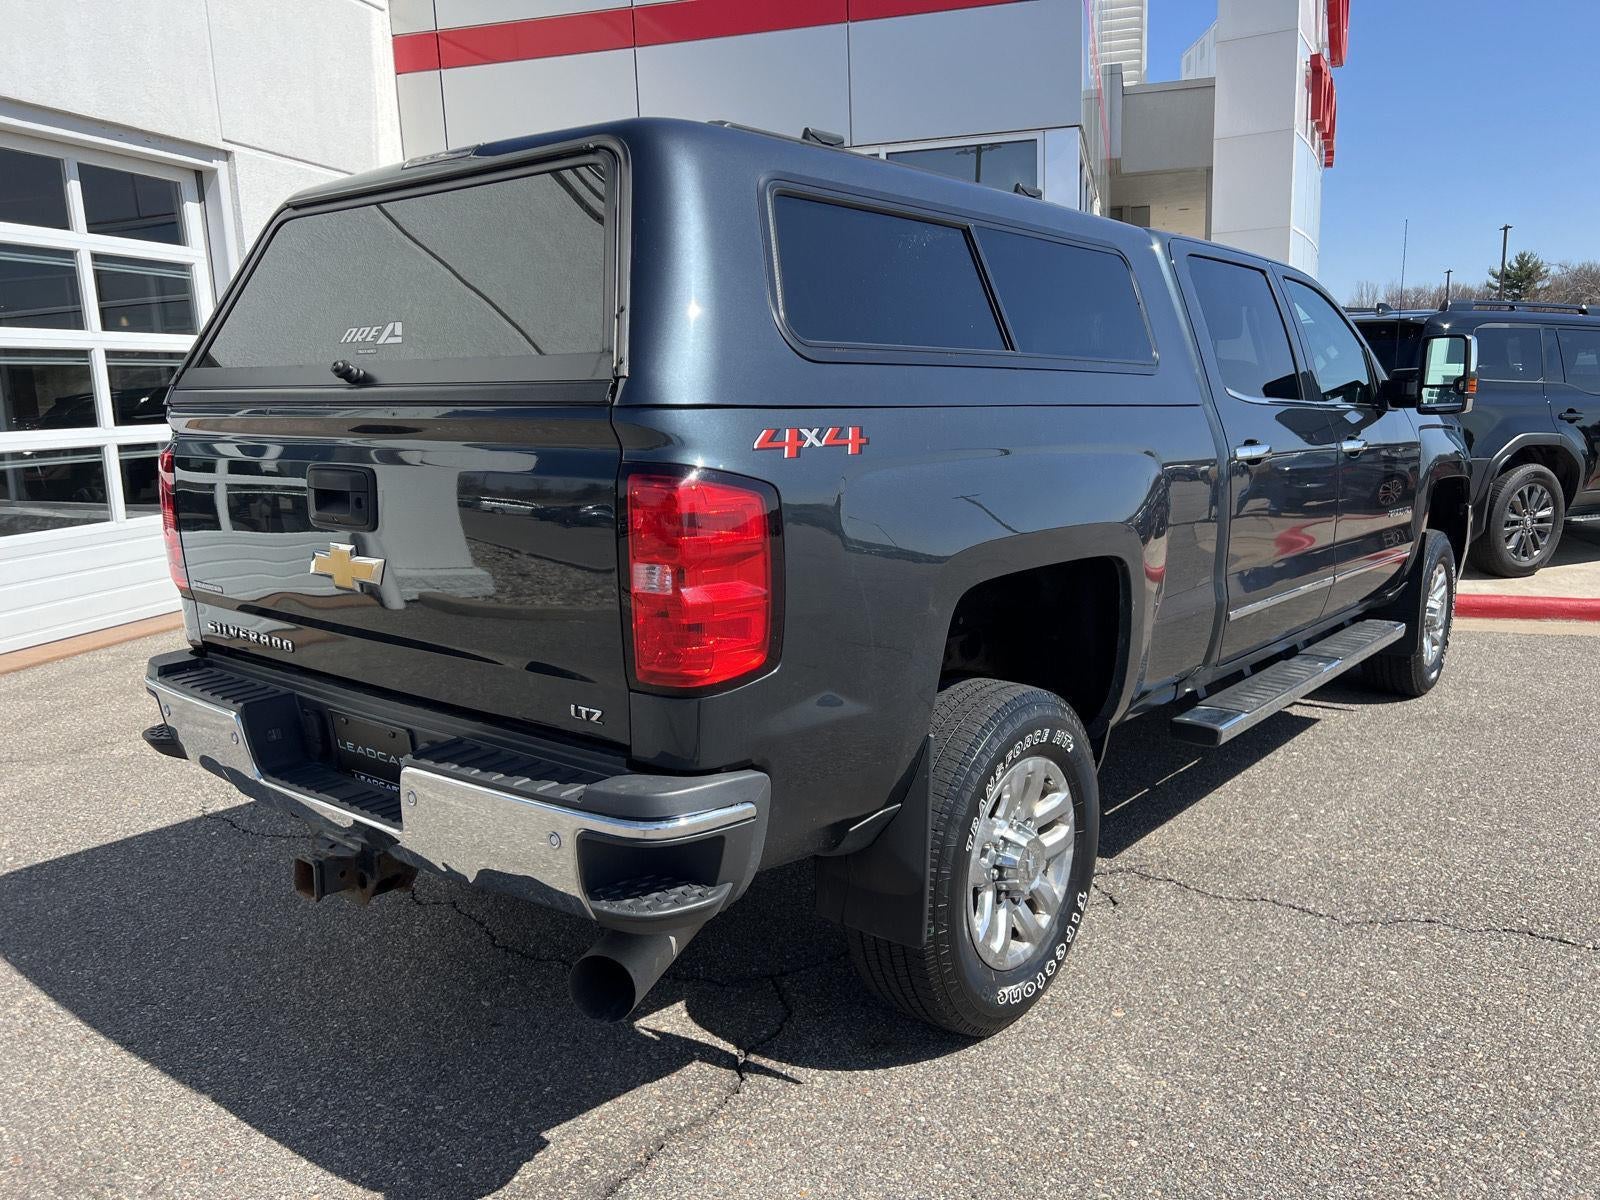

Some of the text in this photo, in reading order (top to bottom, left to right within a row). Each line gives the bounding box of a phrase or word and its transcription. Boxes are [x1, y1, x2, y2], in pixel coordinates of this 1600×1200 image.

[340, 326, 382, 343] ARE
[207, 620, 295, 653] SILVERADO
[570, 703, 603, 725] LTZ
[965, 728, 1050, 852] TRANSFORCE
[996, 891, 1088, 1005] Firestone
